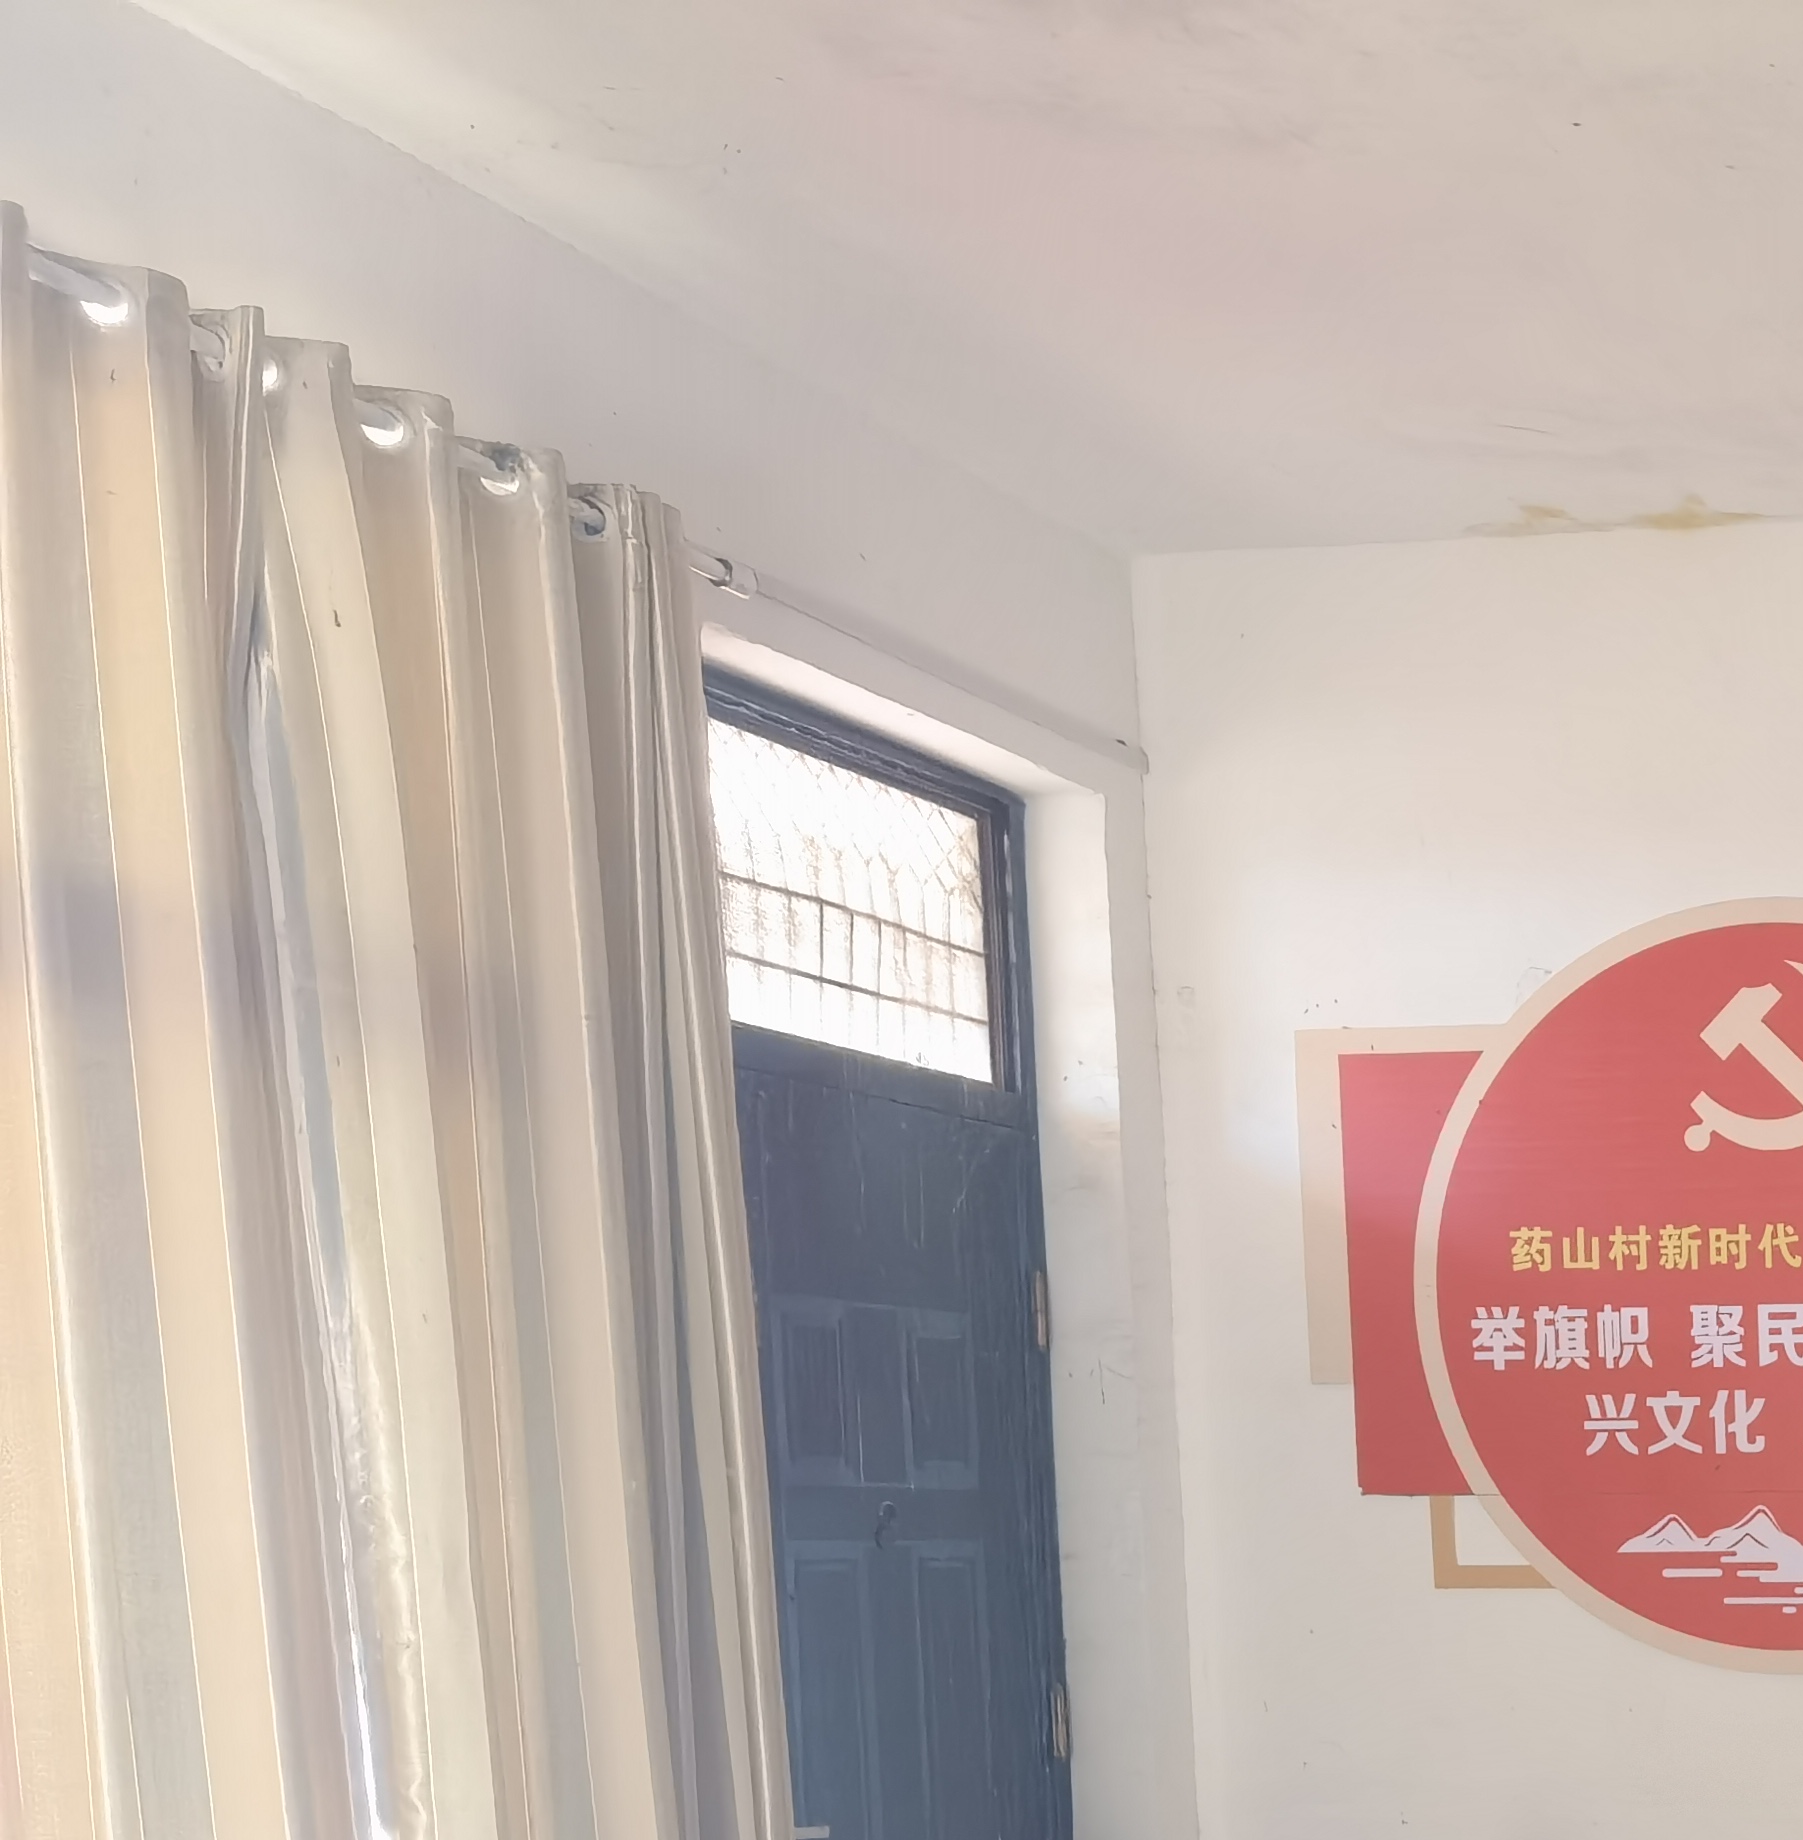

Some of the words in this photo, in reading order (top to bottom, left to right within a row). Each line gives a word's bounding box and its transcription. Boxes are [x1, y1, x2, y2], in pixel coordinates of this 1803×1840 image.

[1470, 1303, 1654, 1371] 举旗帜
[1582, 1389, 1767, 1457] 兴文化
